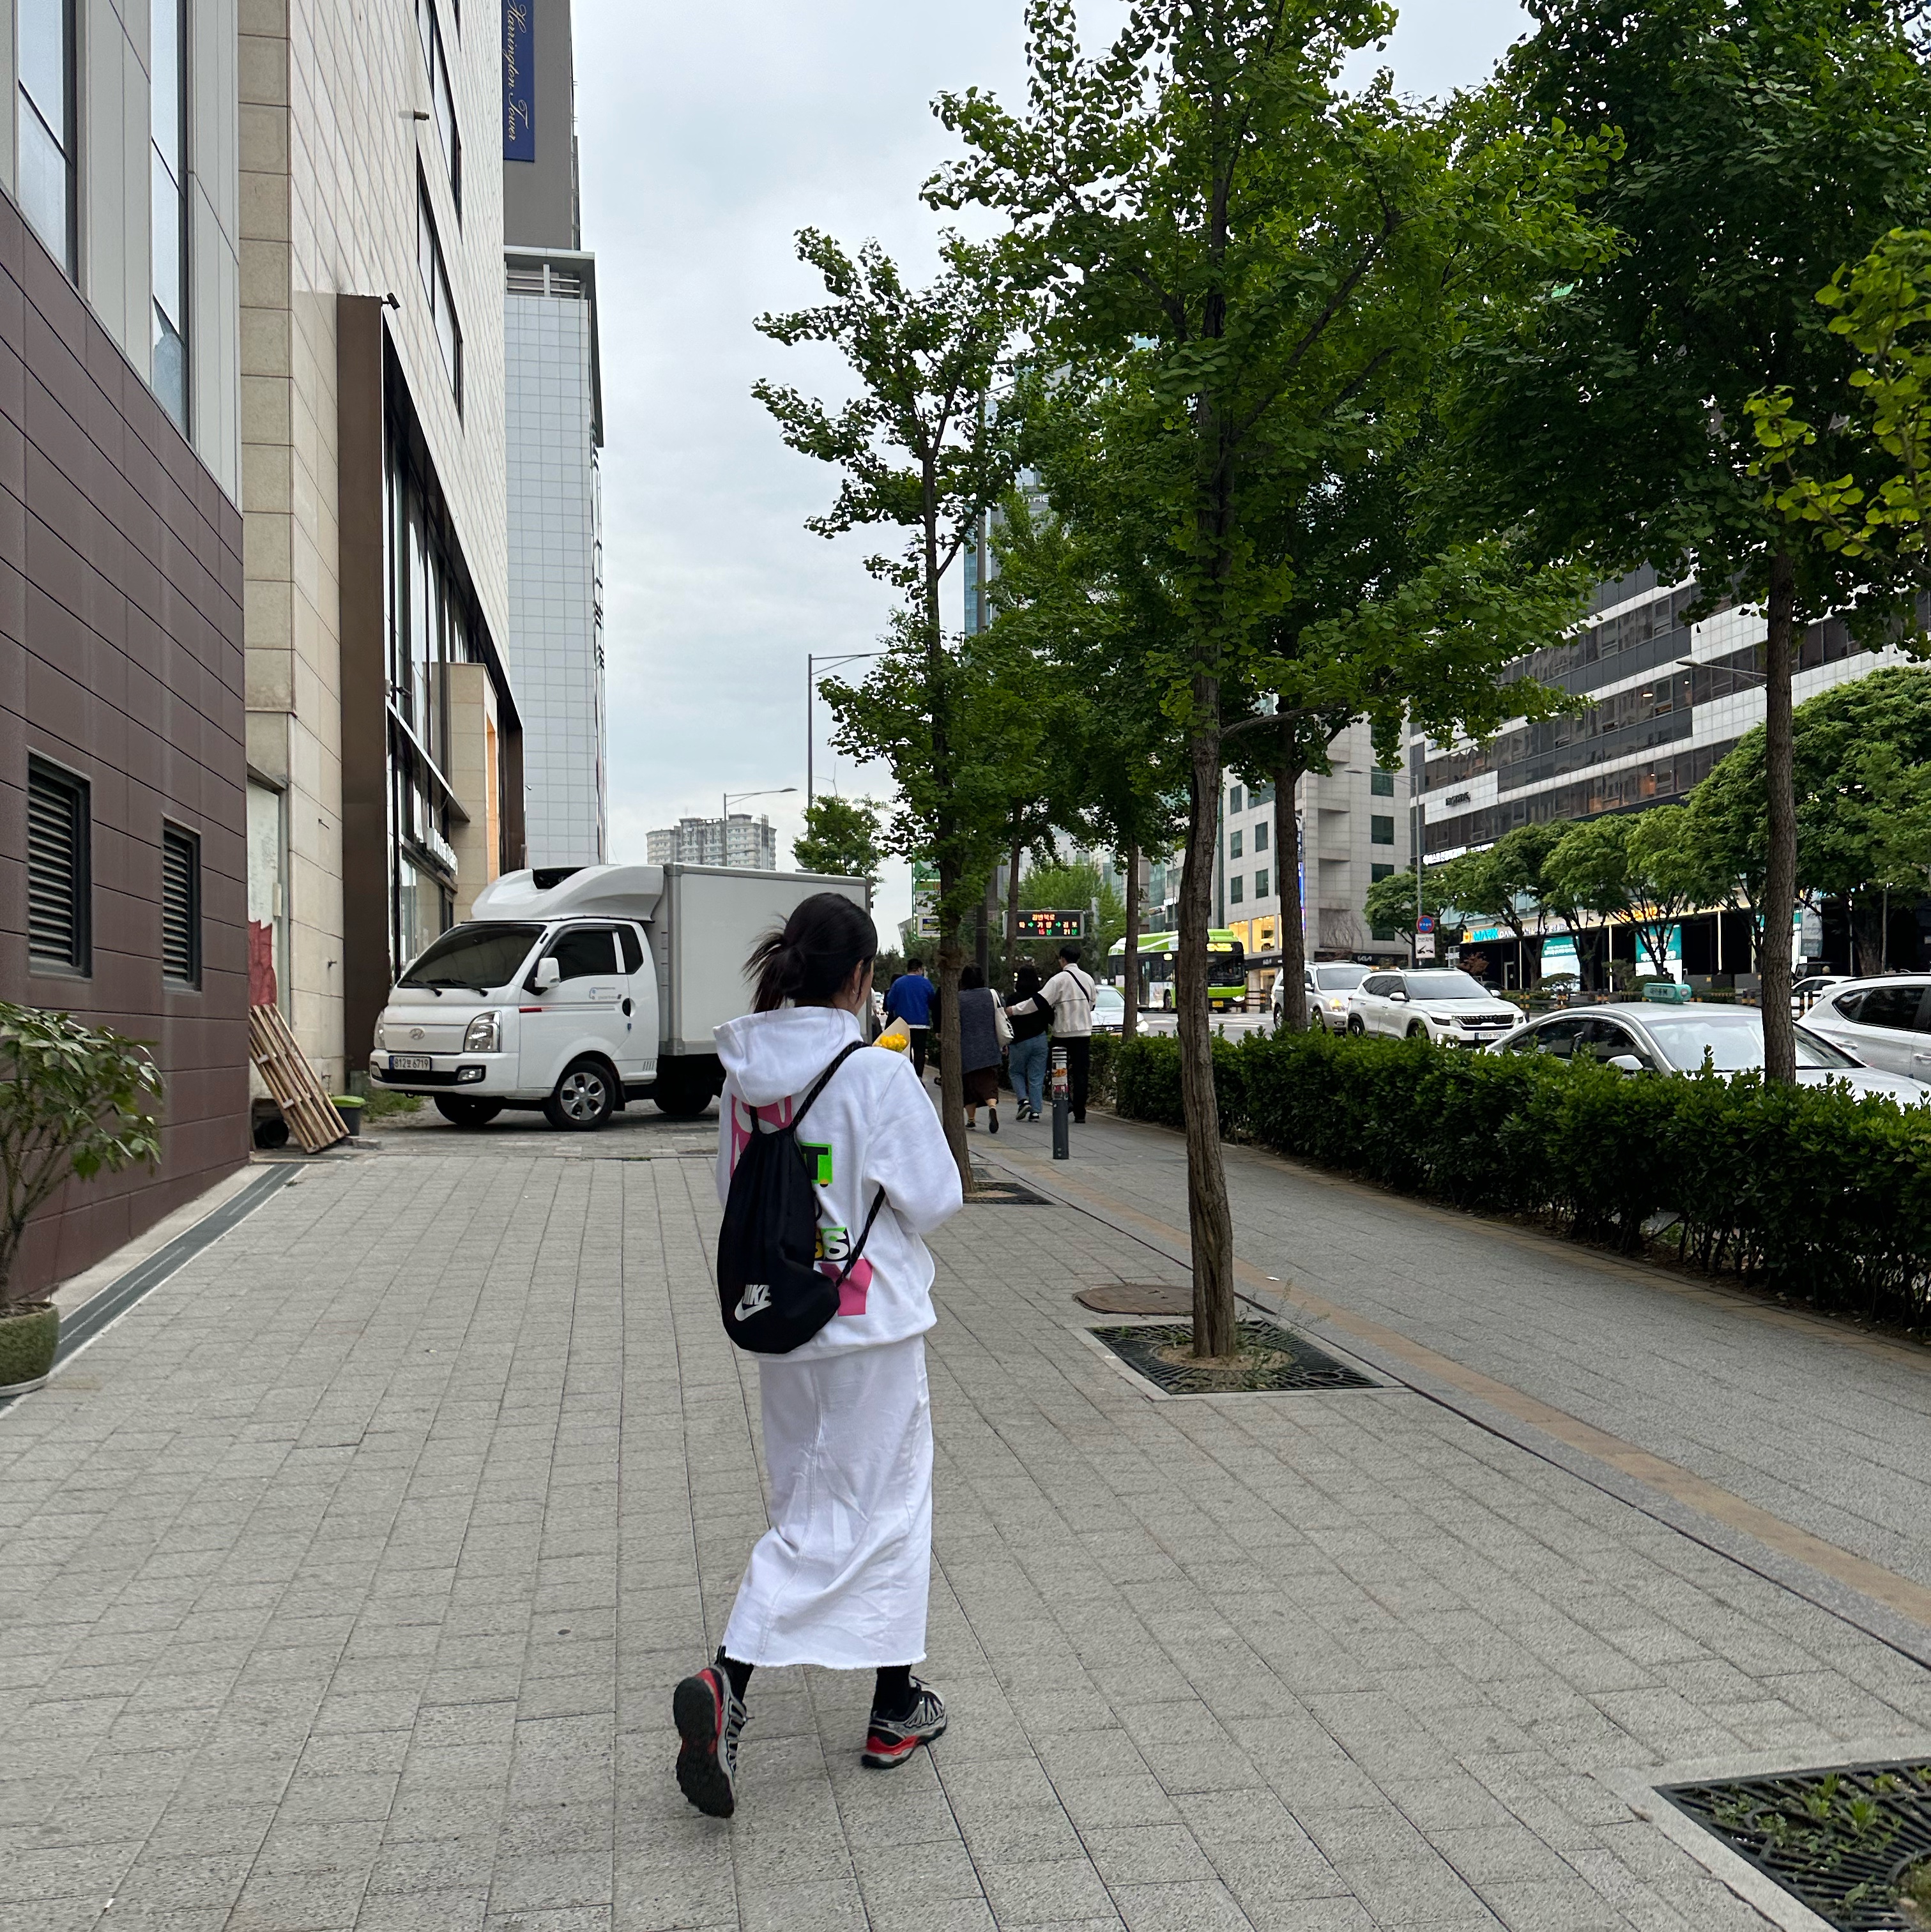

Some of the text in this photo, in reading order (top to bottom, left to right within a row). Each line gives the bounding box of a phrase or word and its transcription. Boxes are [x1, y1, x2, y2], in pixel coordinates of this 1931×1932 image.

[502, 0, 529, 141] Harrington Tower
[1473, 929, 1499, 941] MARK
[743, 1284, 772, 1306] NIKE
